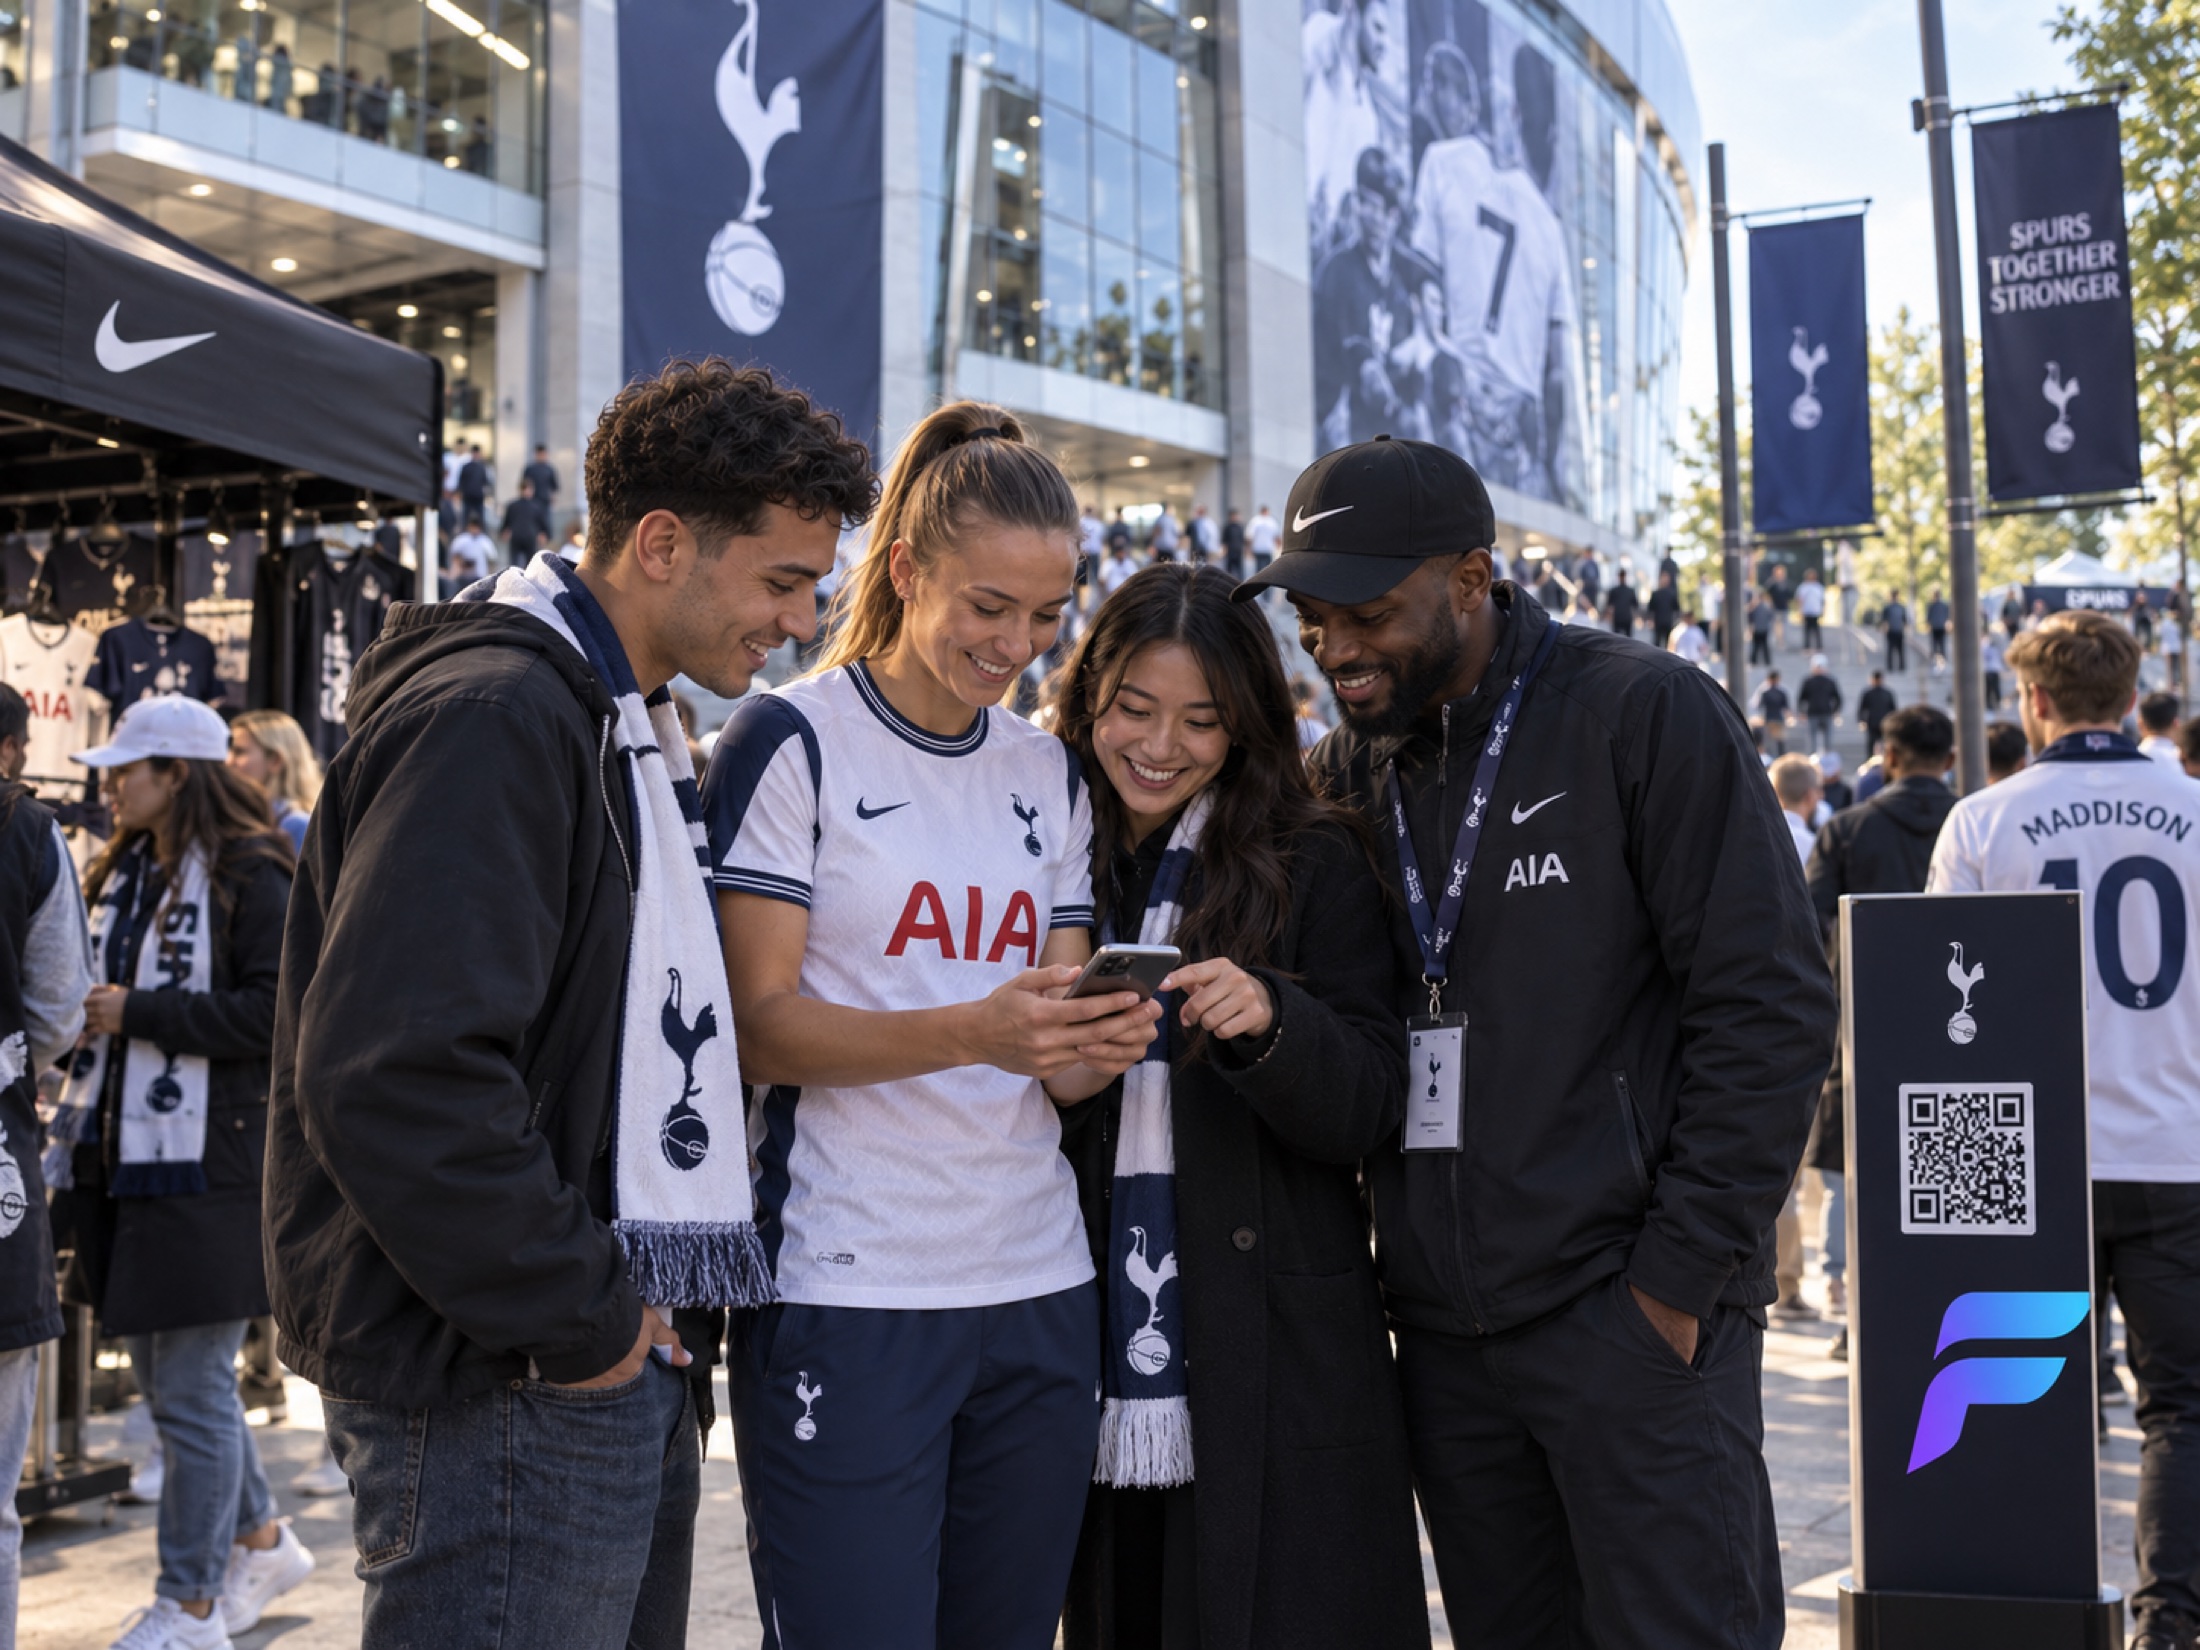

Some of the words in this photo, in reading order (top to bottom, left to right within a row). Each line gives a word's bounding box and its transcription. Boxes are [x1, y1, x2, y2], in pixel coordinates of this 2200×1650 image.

[2010, 212, 2092, 250] SPURS
[1477, 203, 1516, 336] 7
[1987, 240, 2117, 285] TOGETHER
[1990, 272, 2121, 314] STRONGER
[2021, 800, 2192, 846] MADDISON
[1504, 852, 1570, 892] AIA
[883, 880, 1038, 967] AIA
